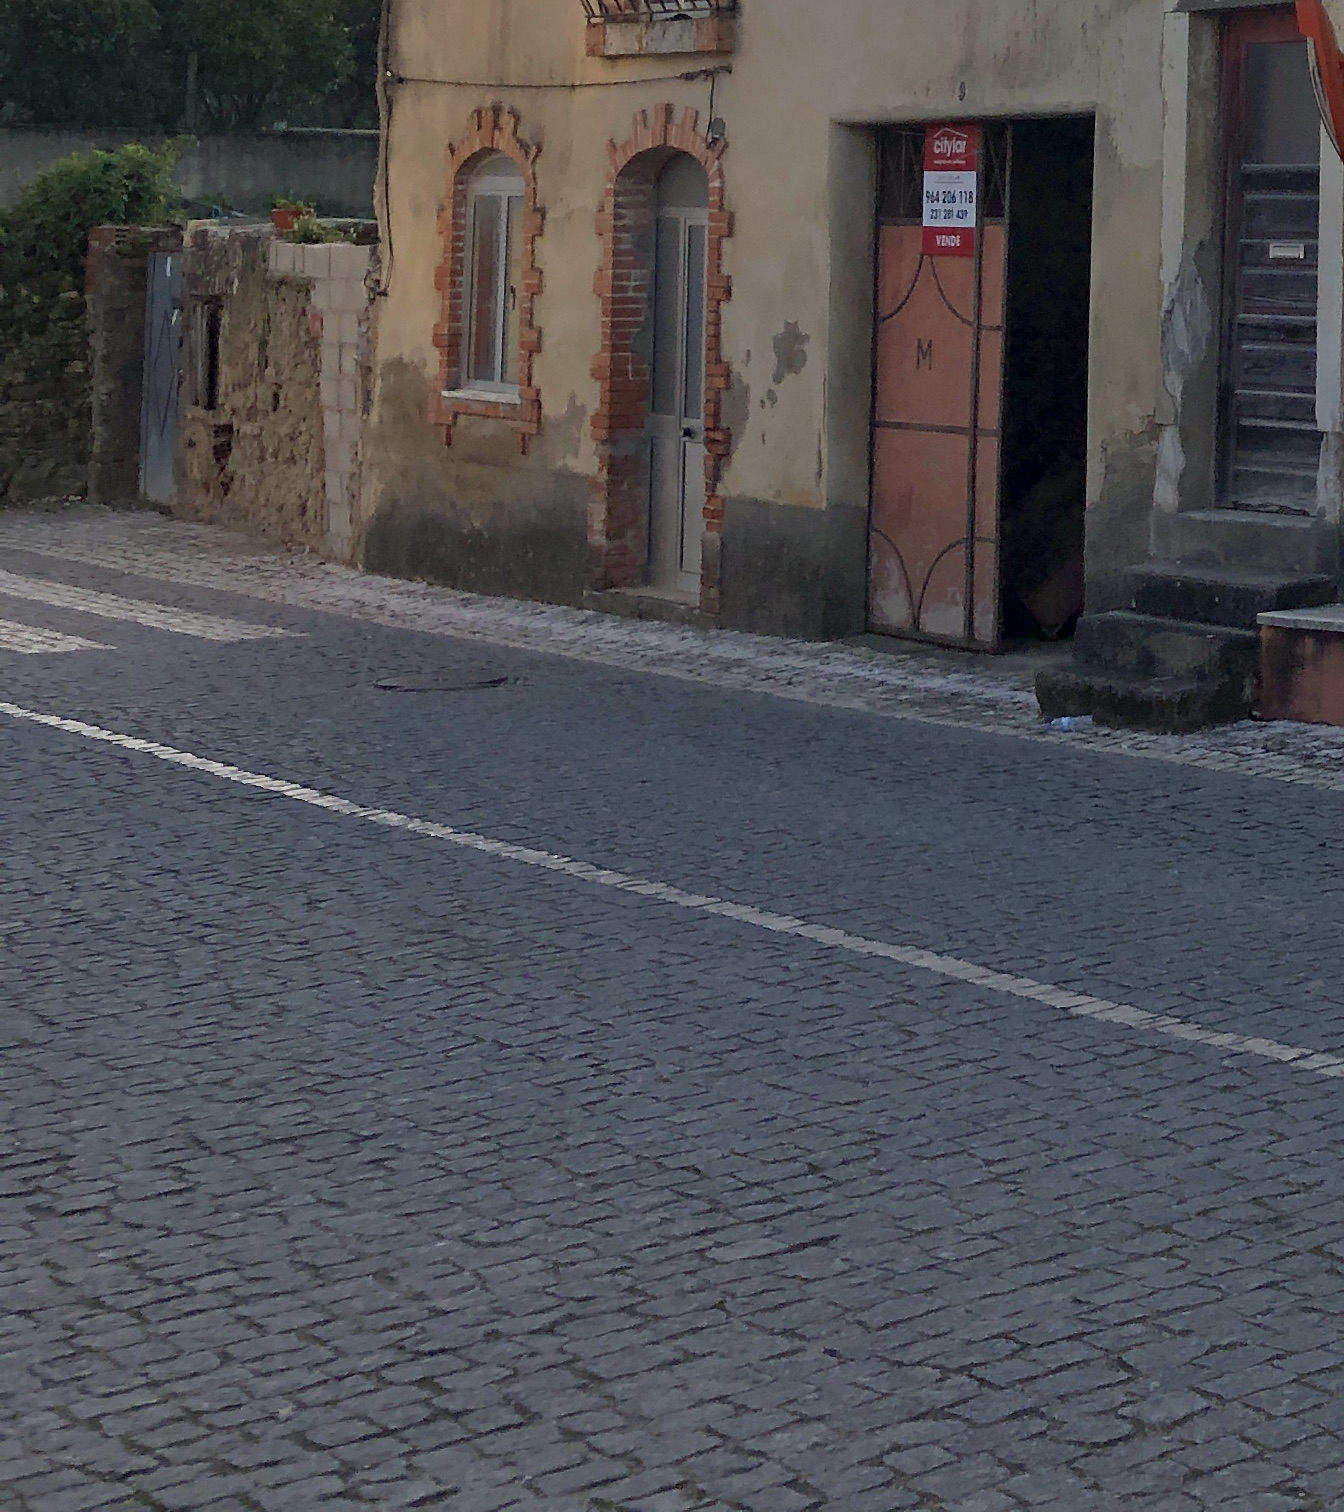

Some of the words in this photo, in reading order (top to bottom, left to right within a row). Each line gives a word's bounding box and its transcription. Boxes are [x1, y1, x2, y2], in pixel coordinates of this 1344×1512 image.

[934, 137, 966, 157] citylar
[925, 191, 940, 204] 964
[942, 190, 957, 204] 206
[959, 190, 974, 204] 118
[936, 234, 961, 247] VENDE
